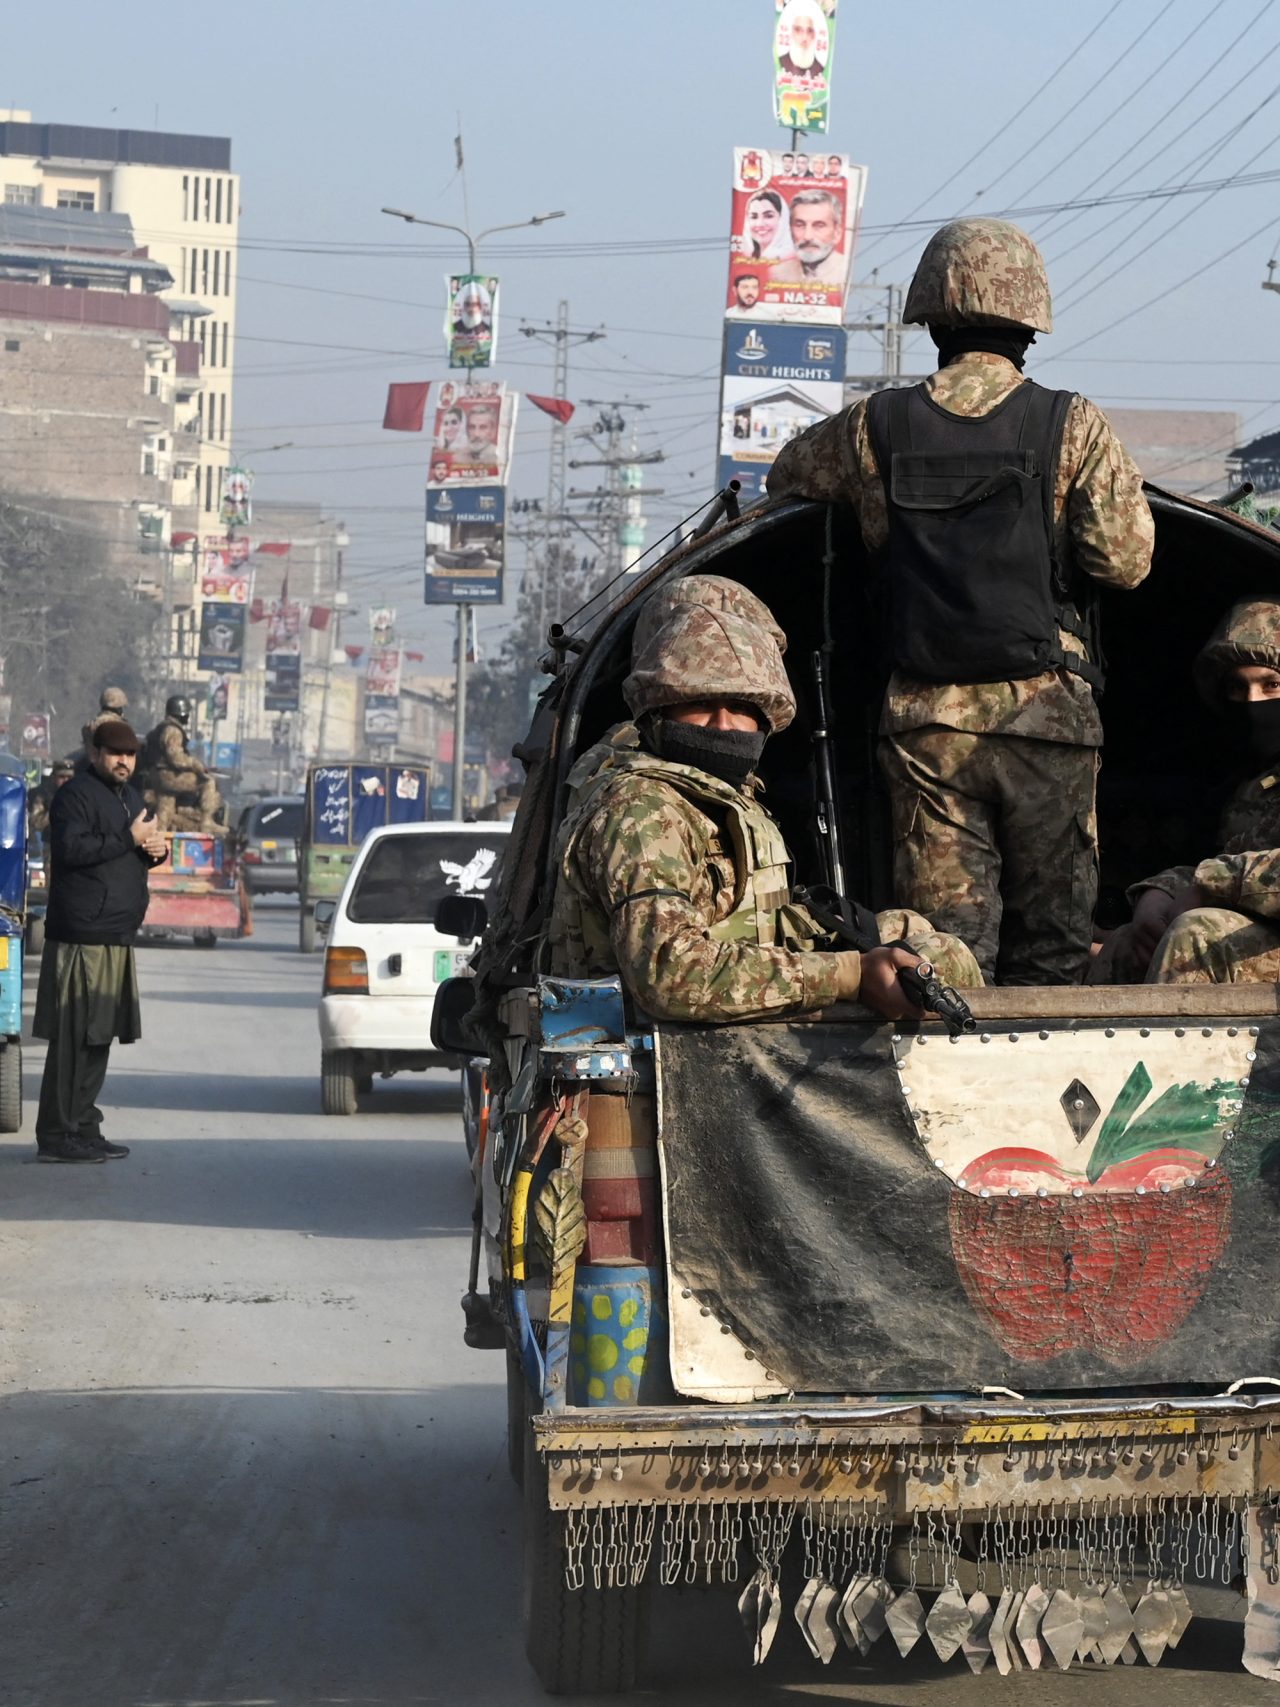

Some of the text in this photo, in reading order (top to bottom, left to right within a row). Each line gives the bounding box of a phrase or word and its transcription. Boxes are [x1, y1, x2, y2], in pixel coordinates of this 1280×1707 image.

[783, 291, 827, 305] NA-32
[738, 364, 831, 380] CITY HEIGHTS
